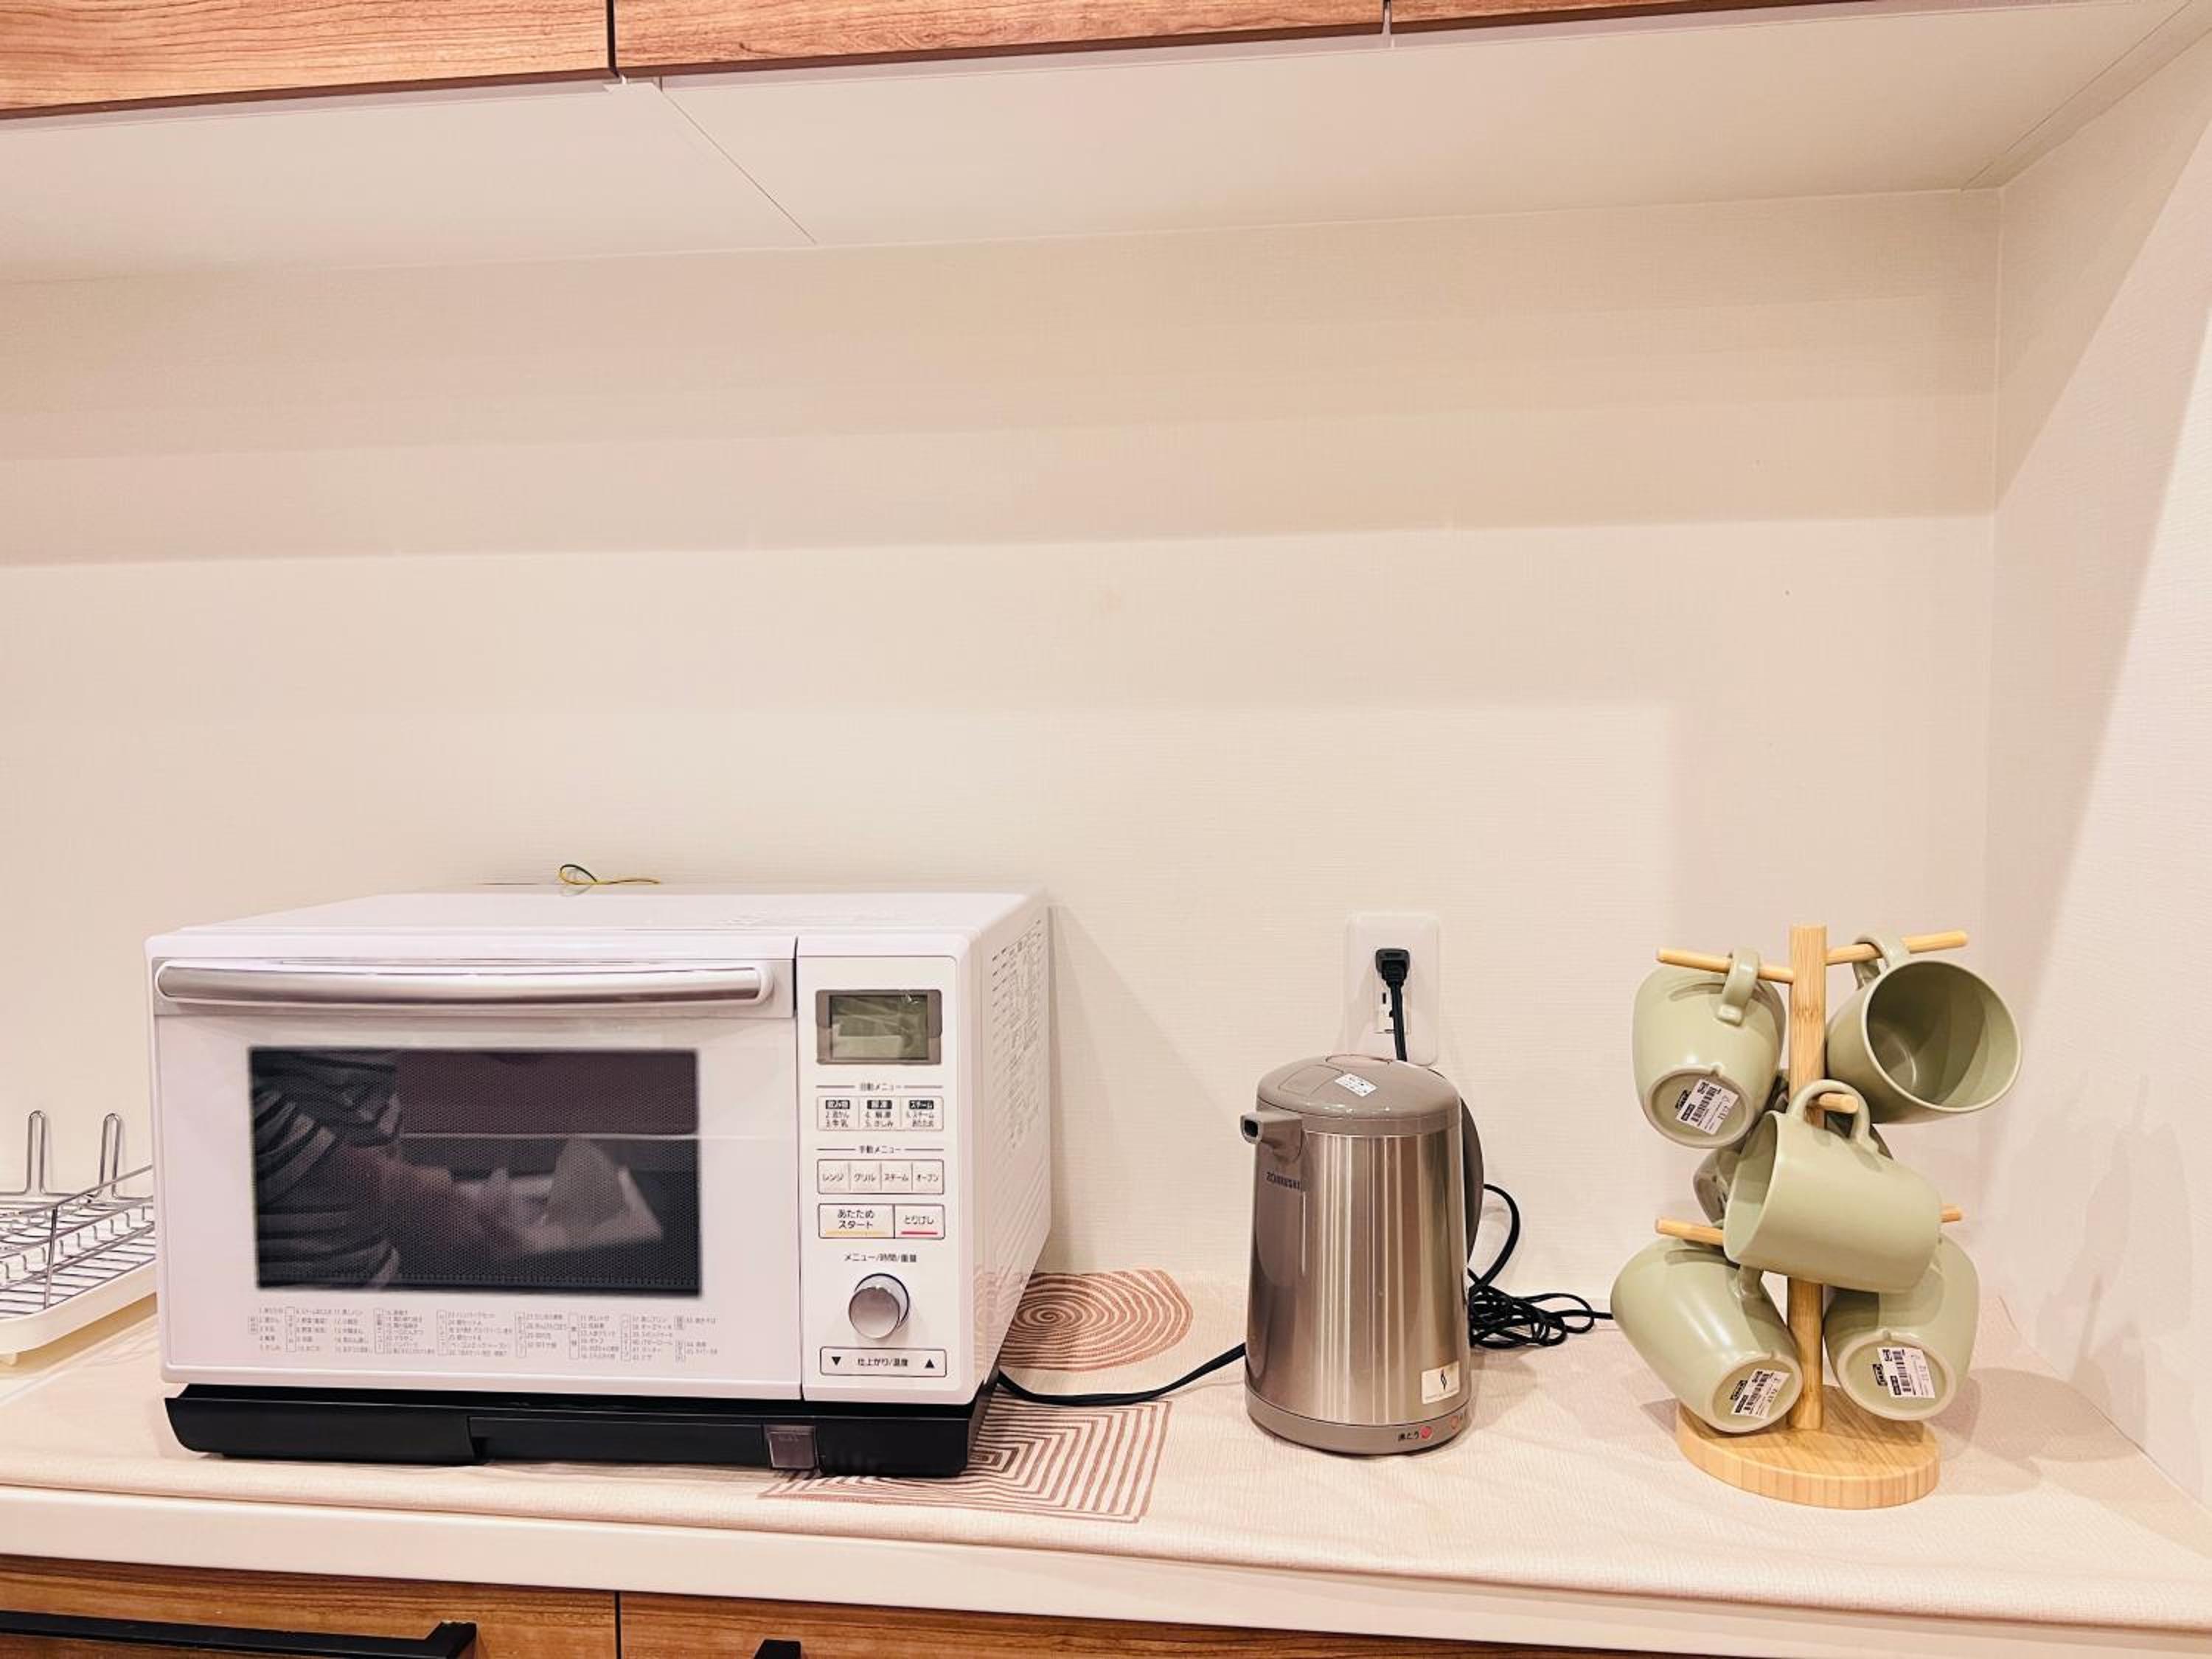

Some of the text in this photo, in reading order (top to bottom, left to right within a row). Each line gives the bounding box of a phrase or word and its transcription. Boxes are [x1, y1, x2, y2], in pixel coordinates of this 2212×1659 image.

[822, 1173, 844, 1181] レンジ
[855, 1173, 875, 1181] グリル
[884, 1173, 908, 1181] スチーム
[838, 1209, 874, 1219] あたため
[904, 1215, 934, 1225] とりけし
[838, 1220, 873, 1229] スタート
